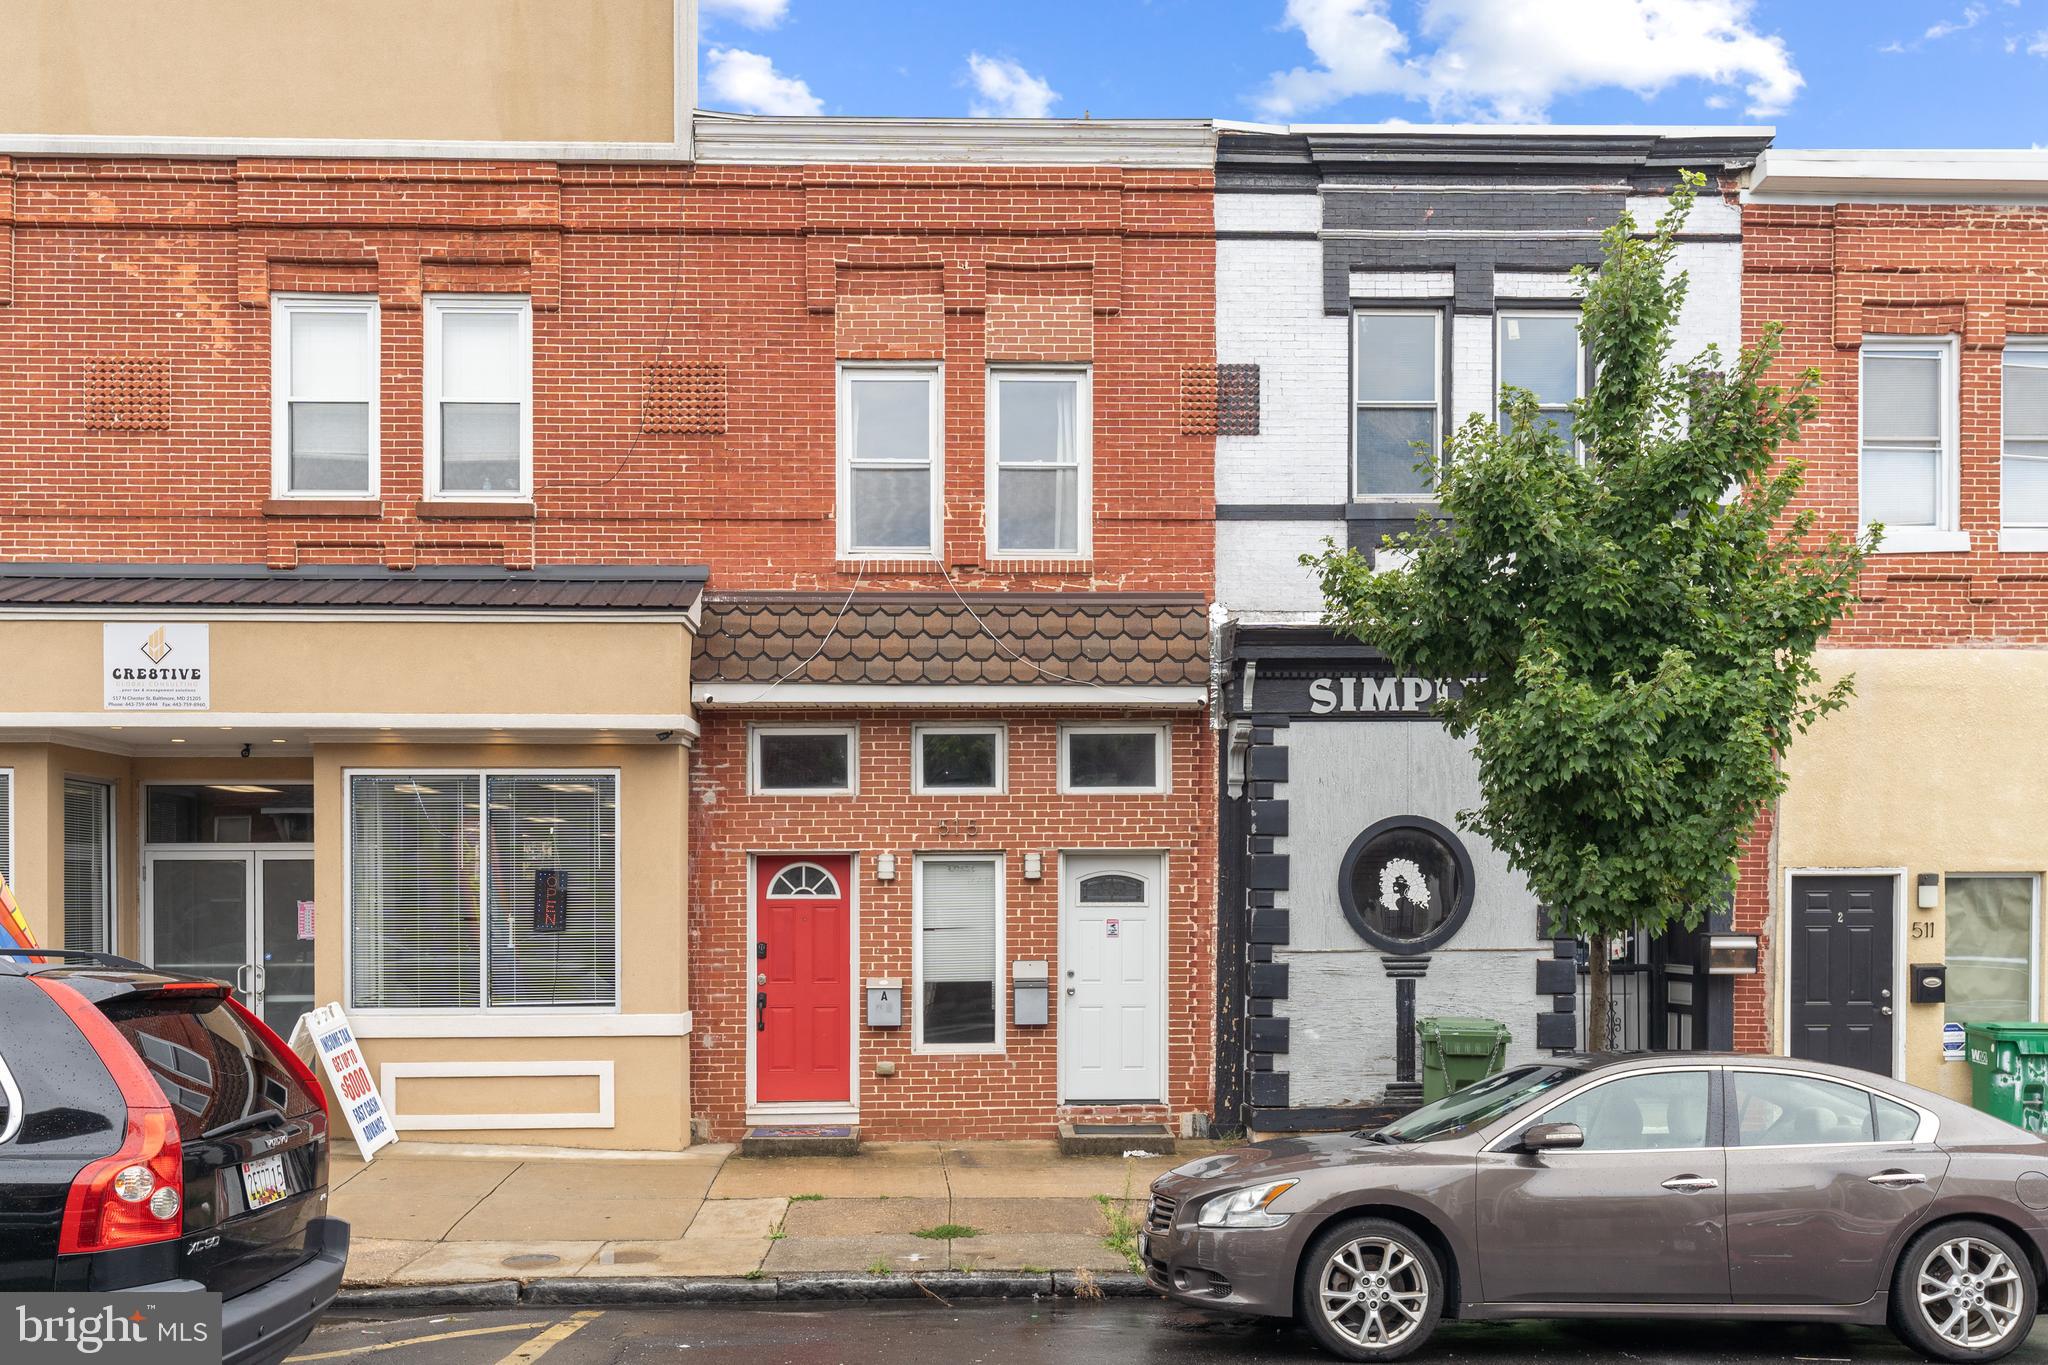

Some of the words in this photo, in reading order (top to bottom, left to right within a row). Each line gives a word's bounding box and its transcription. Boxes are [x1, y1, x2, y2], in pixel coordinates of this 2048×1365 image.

[112, 668, 201, 680] CRE8TIVE
[939, 818, 977, 836] 515
[545, 876, 557, 926] OPEN
[1837, 911, 1844, 923] 2
[1911, 921, 1935, 939] 511
[880, 990, 888, 1001] A
[319, 1031, 343, 1053] INCOME
[338, 1027, 353, 1045] TAX
[331, 1055, 345, 1072] GET
[340, 1052, 351, 1068] UP
[347, 1049, 358, 1065] TO
[340, 1067, 371, 1101] $6000
[352, 1104, 368, 1124] FAST
[363, 1096, 381, 1116] CASH
[362, 1116, 387, 1142] ADVANCE
[187, 1235, 220, 1256] XC90
